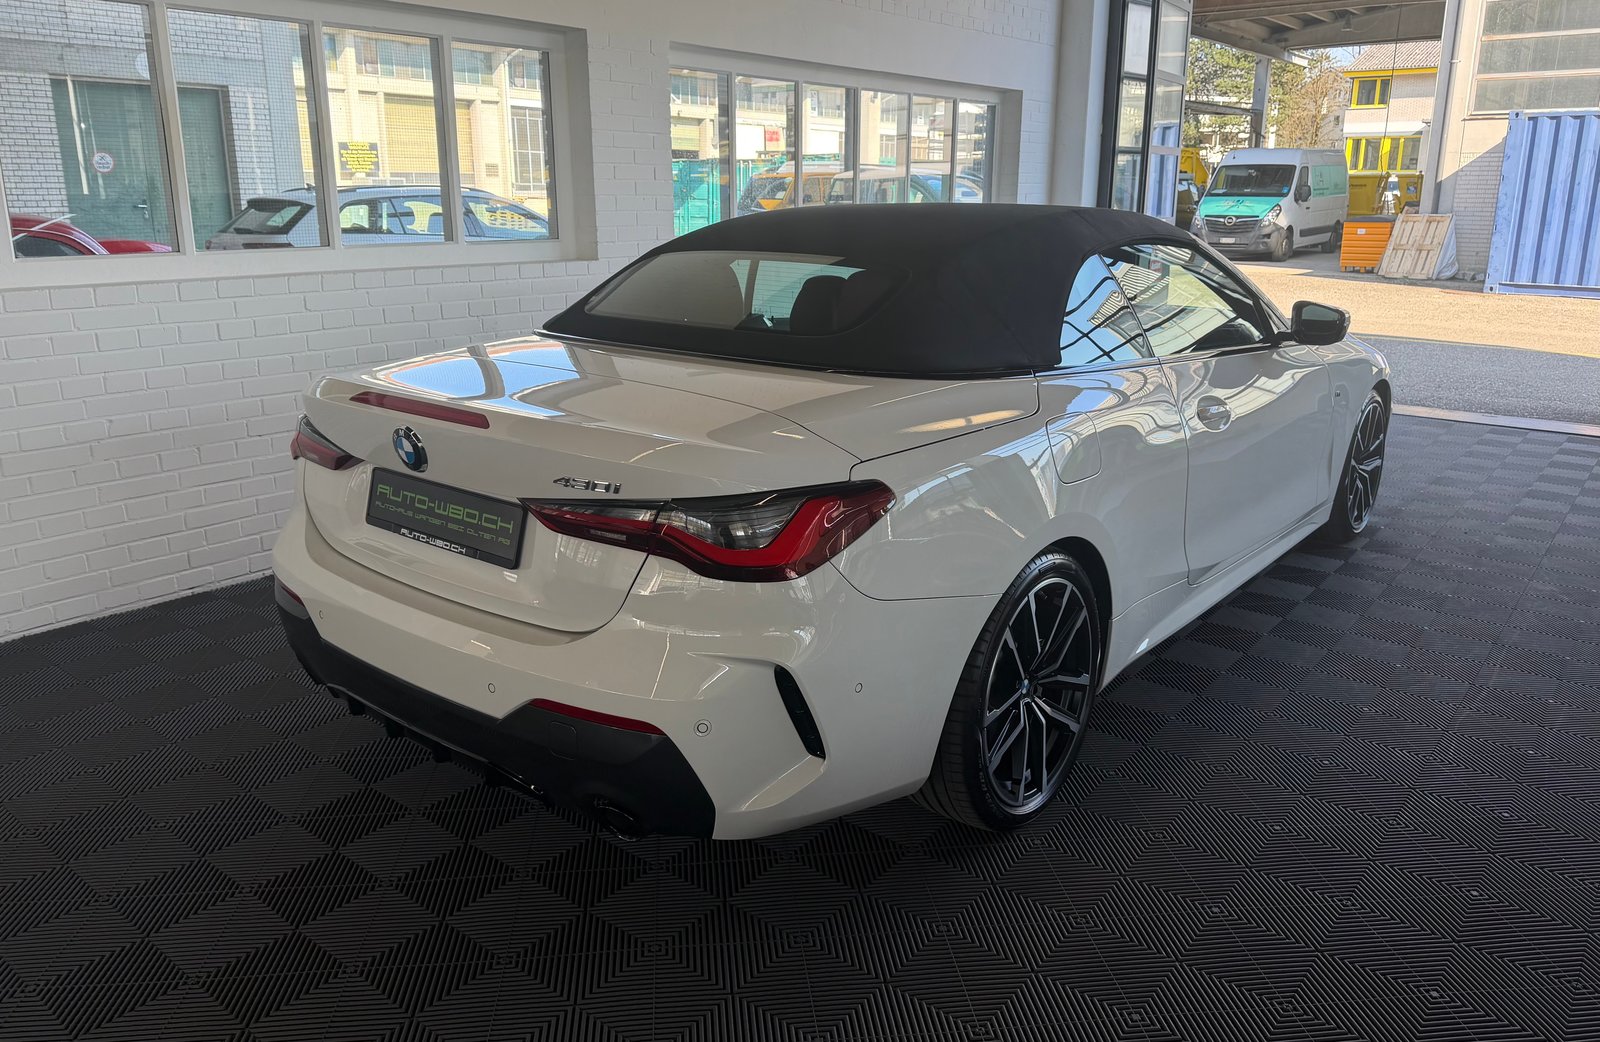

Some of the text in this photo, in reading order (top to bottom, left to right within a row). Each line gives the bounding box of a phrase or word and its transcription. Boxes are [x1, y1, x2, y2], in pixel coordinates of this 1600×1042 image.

[553, 475, 621, 494] 430i
[377, 484, 514, 533] AUTO-WBO.CH
[400, 528, 466, 554] AUTO-WBO.CH
[466, 527, 496, 542] OLTEN
